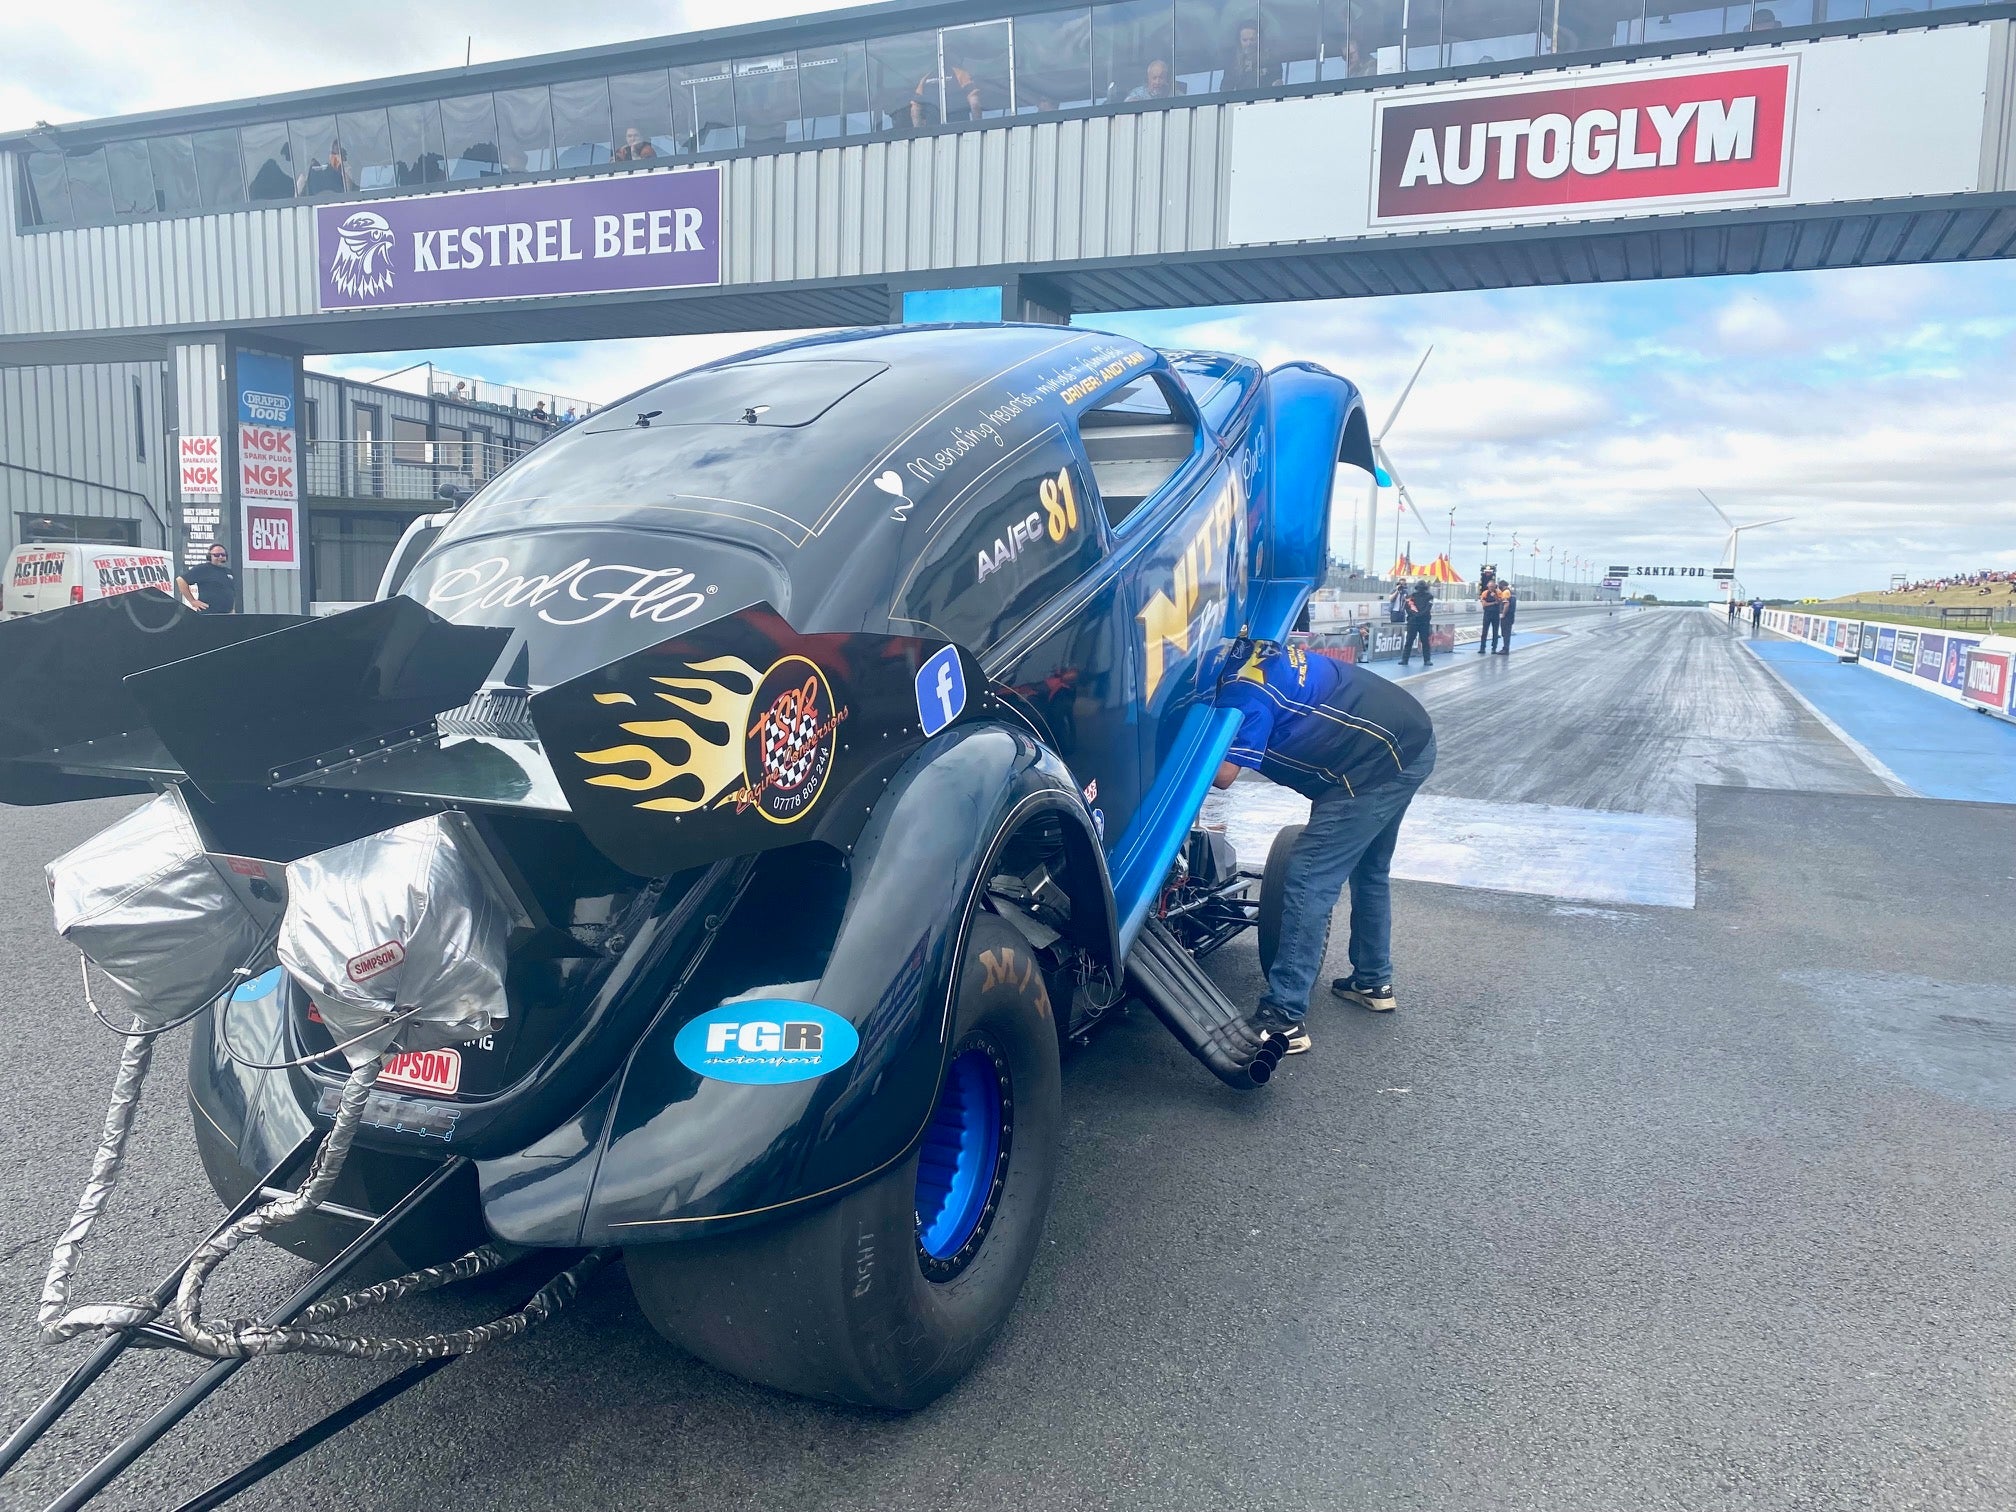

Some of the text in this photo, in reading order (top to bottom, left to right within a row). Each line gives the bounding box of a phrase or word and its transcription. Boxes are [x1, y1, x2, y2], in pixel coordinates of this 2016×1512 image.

[1399, 95, 1757, 188] AUTOGLYM
[413, 207, 705, 272] KESTREL BEER
[1060, 375, 1103, 405] DRIVER:
[1099, 359, 1127, 382] ANDY
[1122, 350, 1146, 367] RAW
[247, 393, 287, 409] DRAPER
[249, 404, 287, 422] Tools
[906, 424, 1004, 484] Mending
[1034, 367, 1077, 396] minds
[182, 438, 217, 456] NGK
[242, 428, 292, 454] NGK
[244, 453, 293, 463] SPARK PLUGS
[183, 467, 218, 484] NGK
[244, 464, 293, 488] NGK
[245, 488, 294, 497] SPARK PLUGS
[1039, 466, 1078, 543] 81
[252, 518, 289, 535] AUTO
[252, 532, 290, 551] GLYM
[978, 511, 1044, 584] AA/FC
[45, 552, 66, 560] MOST
[93, 560, 112, 570] THE
[139, 557, 165, 566] MOST
[14, 561, 65, 579] ACTION
[99, 565, 171, 587] ACTION
[1636, 566, 1705, 577] SANTA POD
[1374, 632, 1402, 653] Santa
[748, 675, 818, 763] TSR
[736, 704, 849, 815] Engine Conversions
[773, 794, 801, 811] 07778
[802, 775, 818, 800] 805
[354, 948, 396, 975] SIMPSON
[706, 1021, 824, 1052] FGR
[703, 1053, 823, 1068] motorsport
